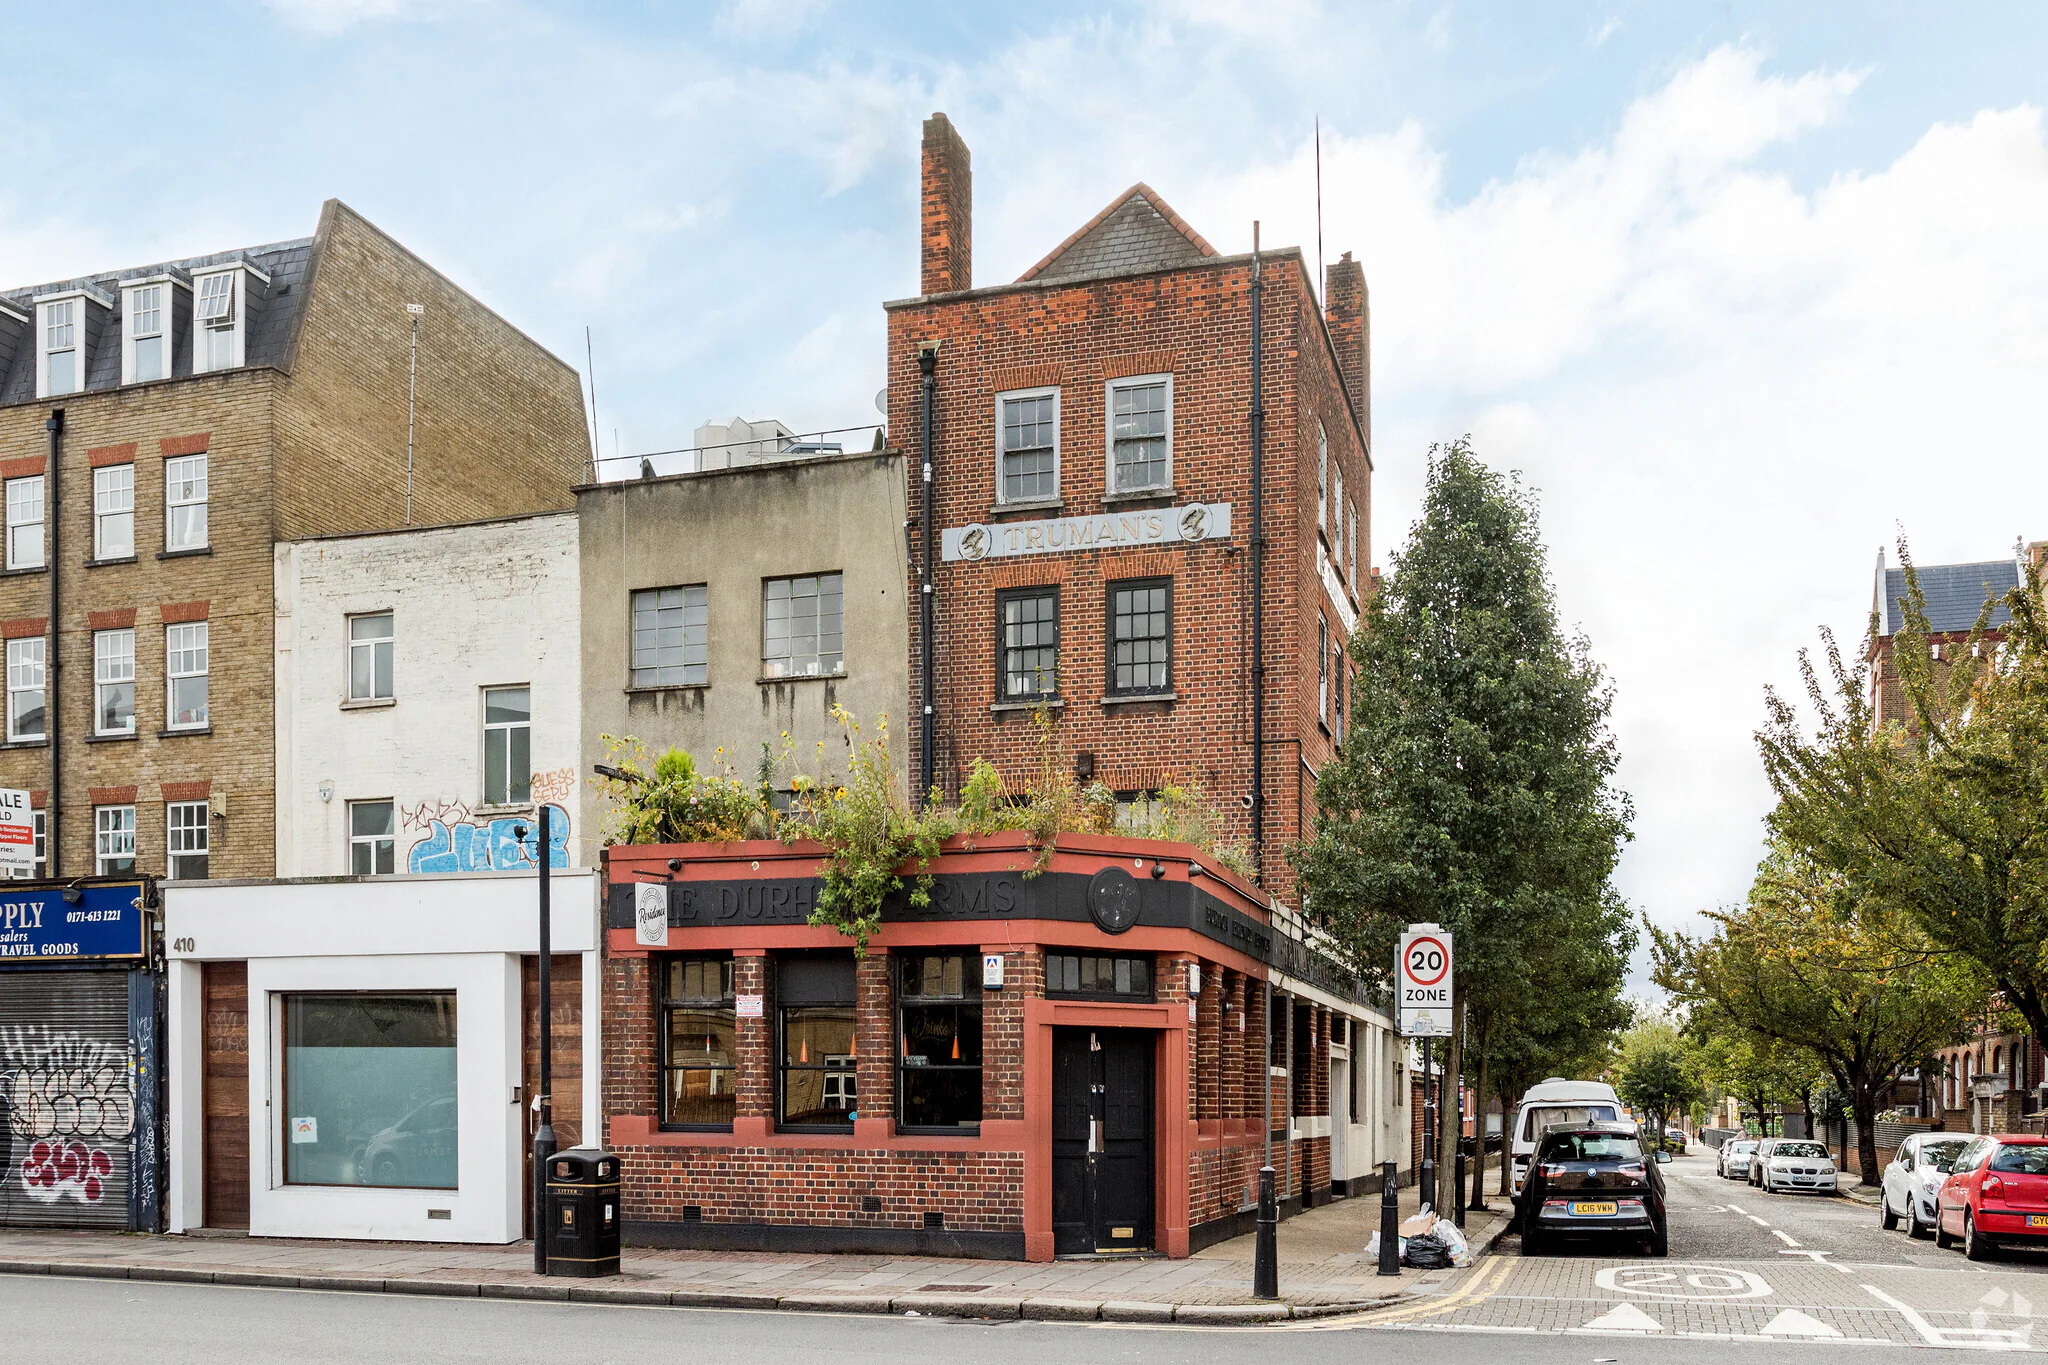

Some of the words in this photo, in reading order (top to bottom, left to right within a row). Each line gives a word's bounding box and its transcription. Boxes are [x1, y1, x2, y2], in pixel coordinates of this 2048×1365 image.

[1004, 513, 1163, 550] TRUMAN'S
[532, 768, 575, 789] GUESS
[103, 909, 121, 921] 1221
[638, 905, 666, 924] Residence
[0, 944, 36, 956] RAVEL
[41, 943, 79, 955] GOODS
[173, 937, 195, 953] 410
[1411, 951, 1442, 971] 20
[1406, 989, 1447, 1001] ZONE
[1621, 1271, 1744, 1291] 20
